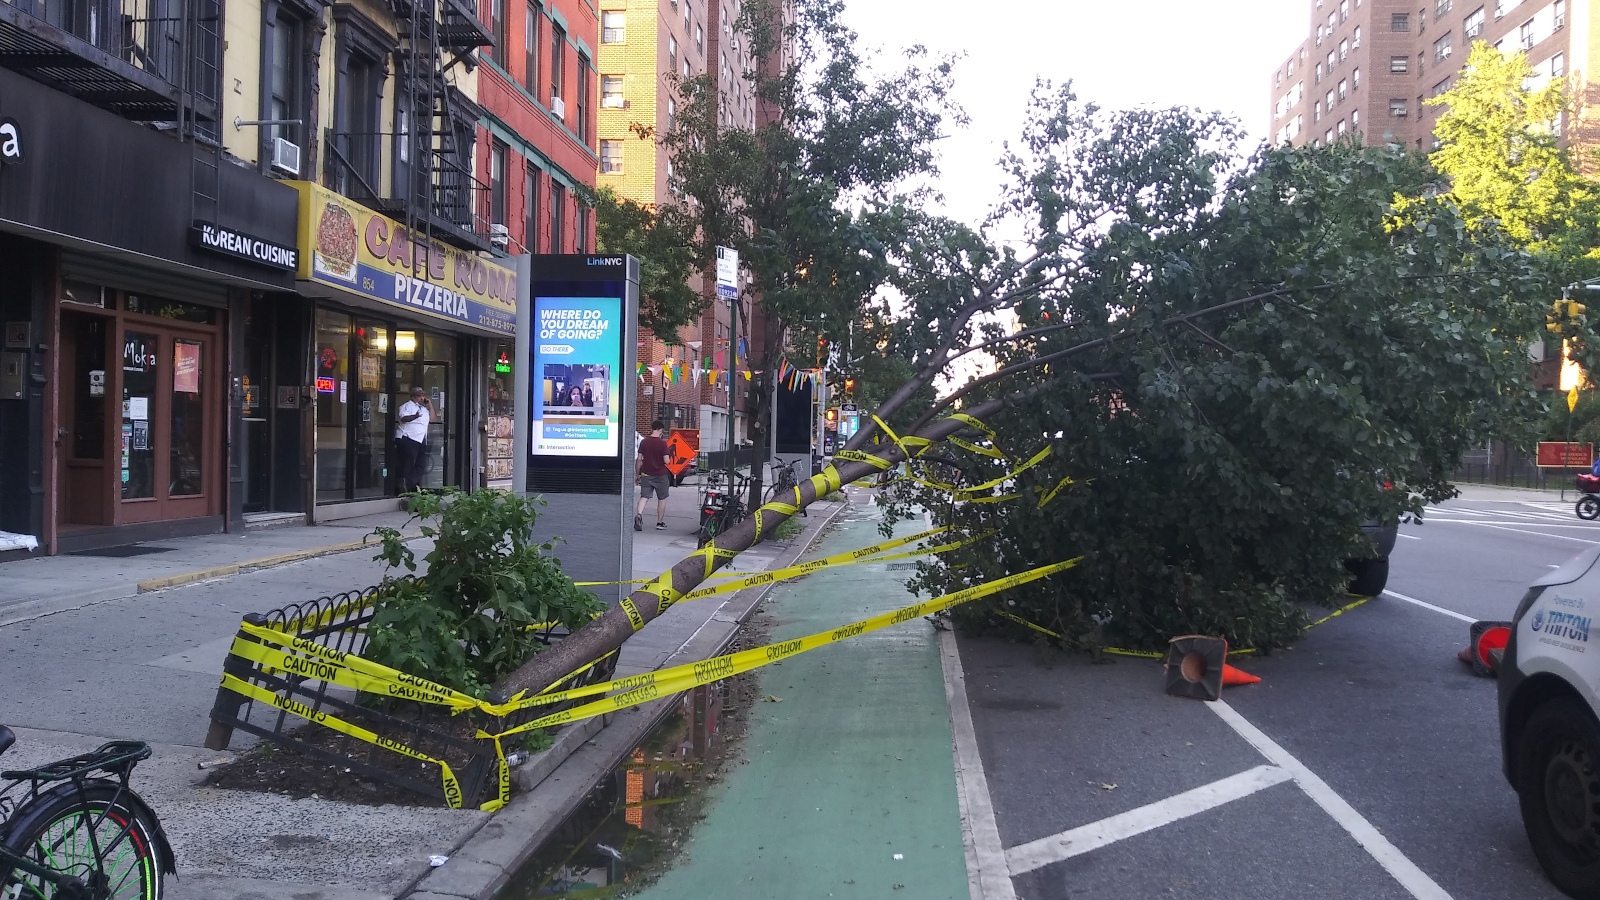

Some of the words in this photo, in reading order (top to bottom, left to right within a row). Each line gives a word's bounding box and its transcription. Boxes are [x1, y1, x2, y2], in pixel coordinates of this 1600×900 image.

[203, 225, 252, 256] KOREAN
[253, 241, 296, 268] CUISINE
[365, 215, 446, 281] CAFE
[587, 257, 622, 266] LinkNYC
[362, 276, 375, 291] 854
[394, 272, 469, 319] PIZZERIA
[541, 309, 583, 320] WHERE
[583, 310, 602, 320] DO
[479, 315, 517, 332] 212-875-8972
[540, 319, 565, 330] YOU
[566, 320, 609, 330] DREAM
[540, 329, 557, 339] OF
[557, 330, 603, 340] GOING?
[123, 342, 156, 373] Mokja
[316, 379, 333, 391] OPEN
[852, 545, 881, 559] CAUTION
[800, 558, 829, 573] CAUTION
[744, 573, 774, 587] CAUTION
[685, 587, 717, 600] CAUTION
[1544, 610, 1592, 642] TRITON
[292, 637, 348, 662] CAUTION
[283, 655, 338, 681] CAUTION
[397, 673, 453, 697] CAUTION
[273, 694, 327, 722] CAUTION
